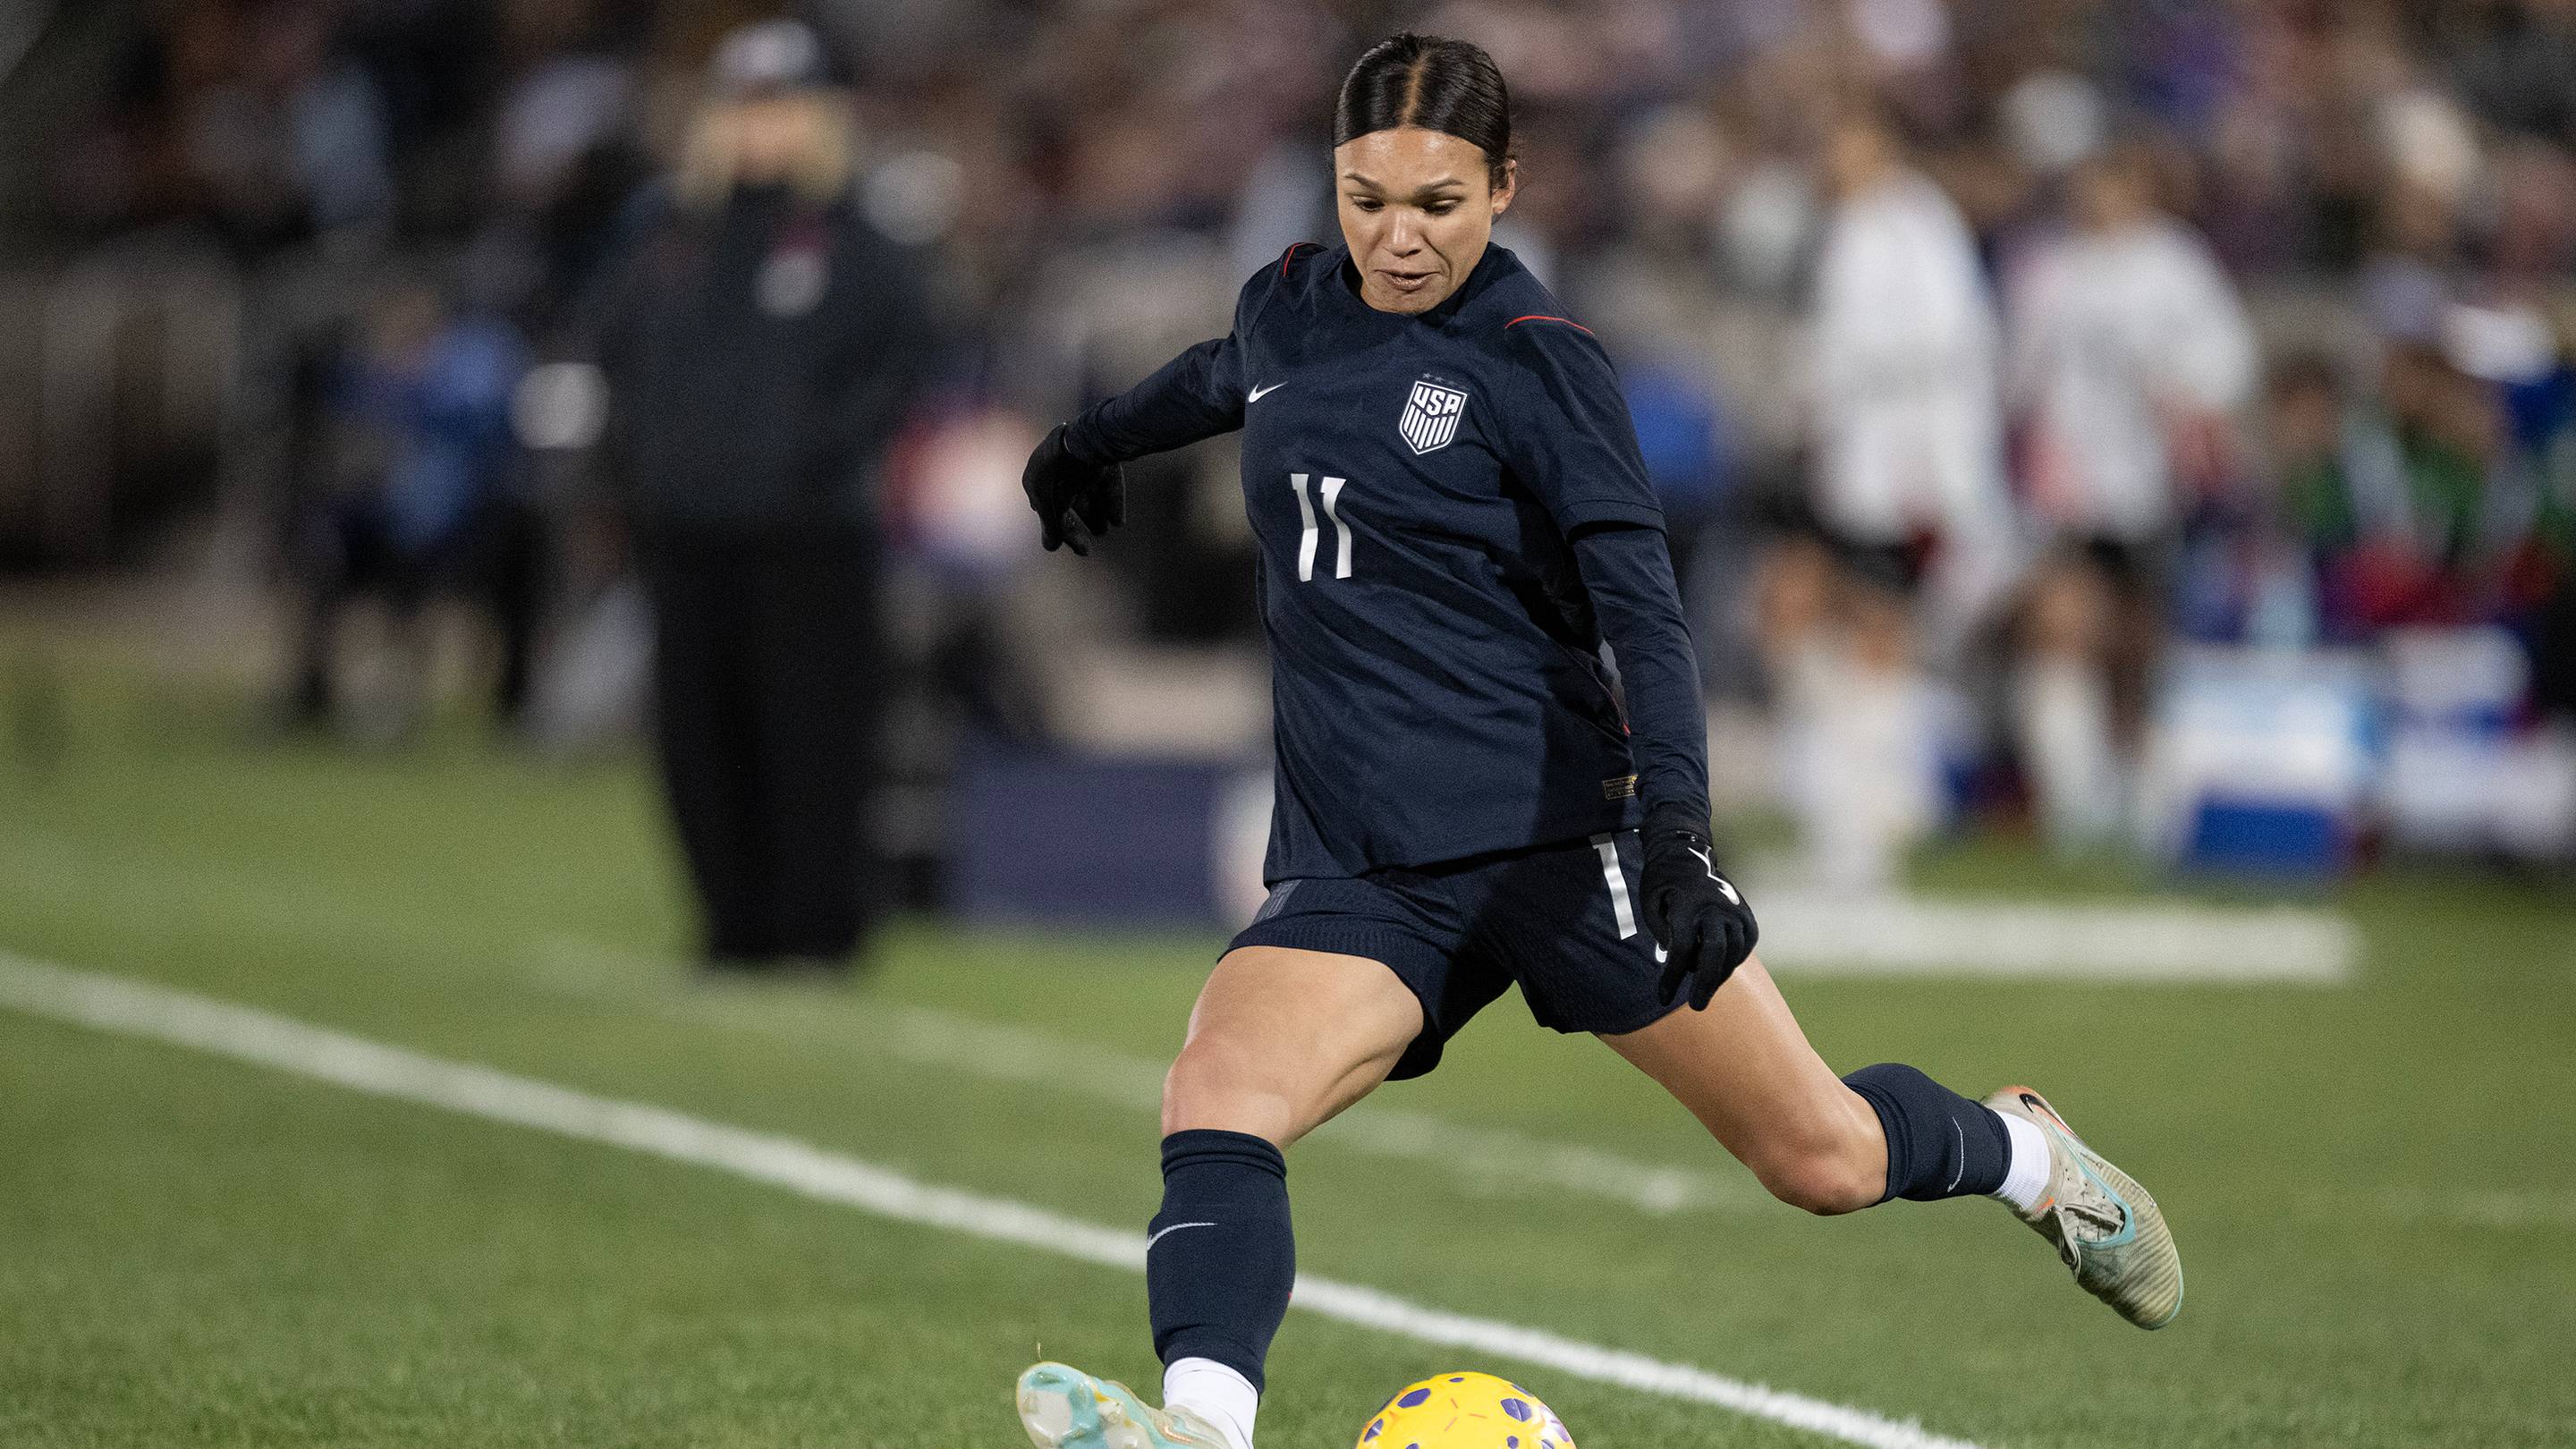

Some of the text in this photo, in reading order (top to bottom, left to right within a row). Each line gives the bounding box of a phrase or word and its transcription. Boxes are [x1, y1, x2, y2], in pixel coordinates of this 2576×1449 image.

[1413, 386, 1462, 416] USA
[1291, 473, 1352, 582] 11
[1589, 828, 1639, 940] 1
